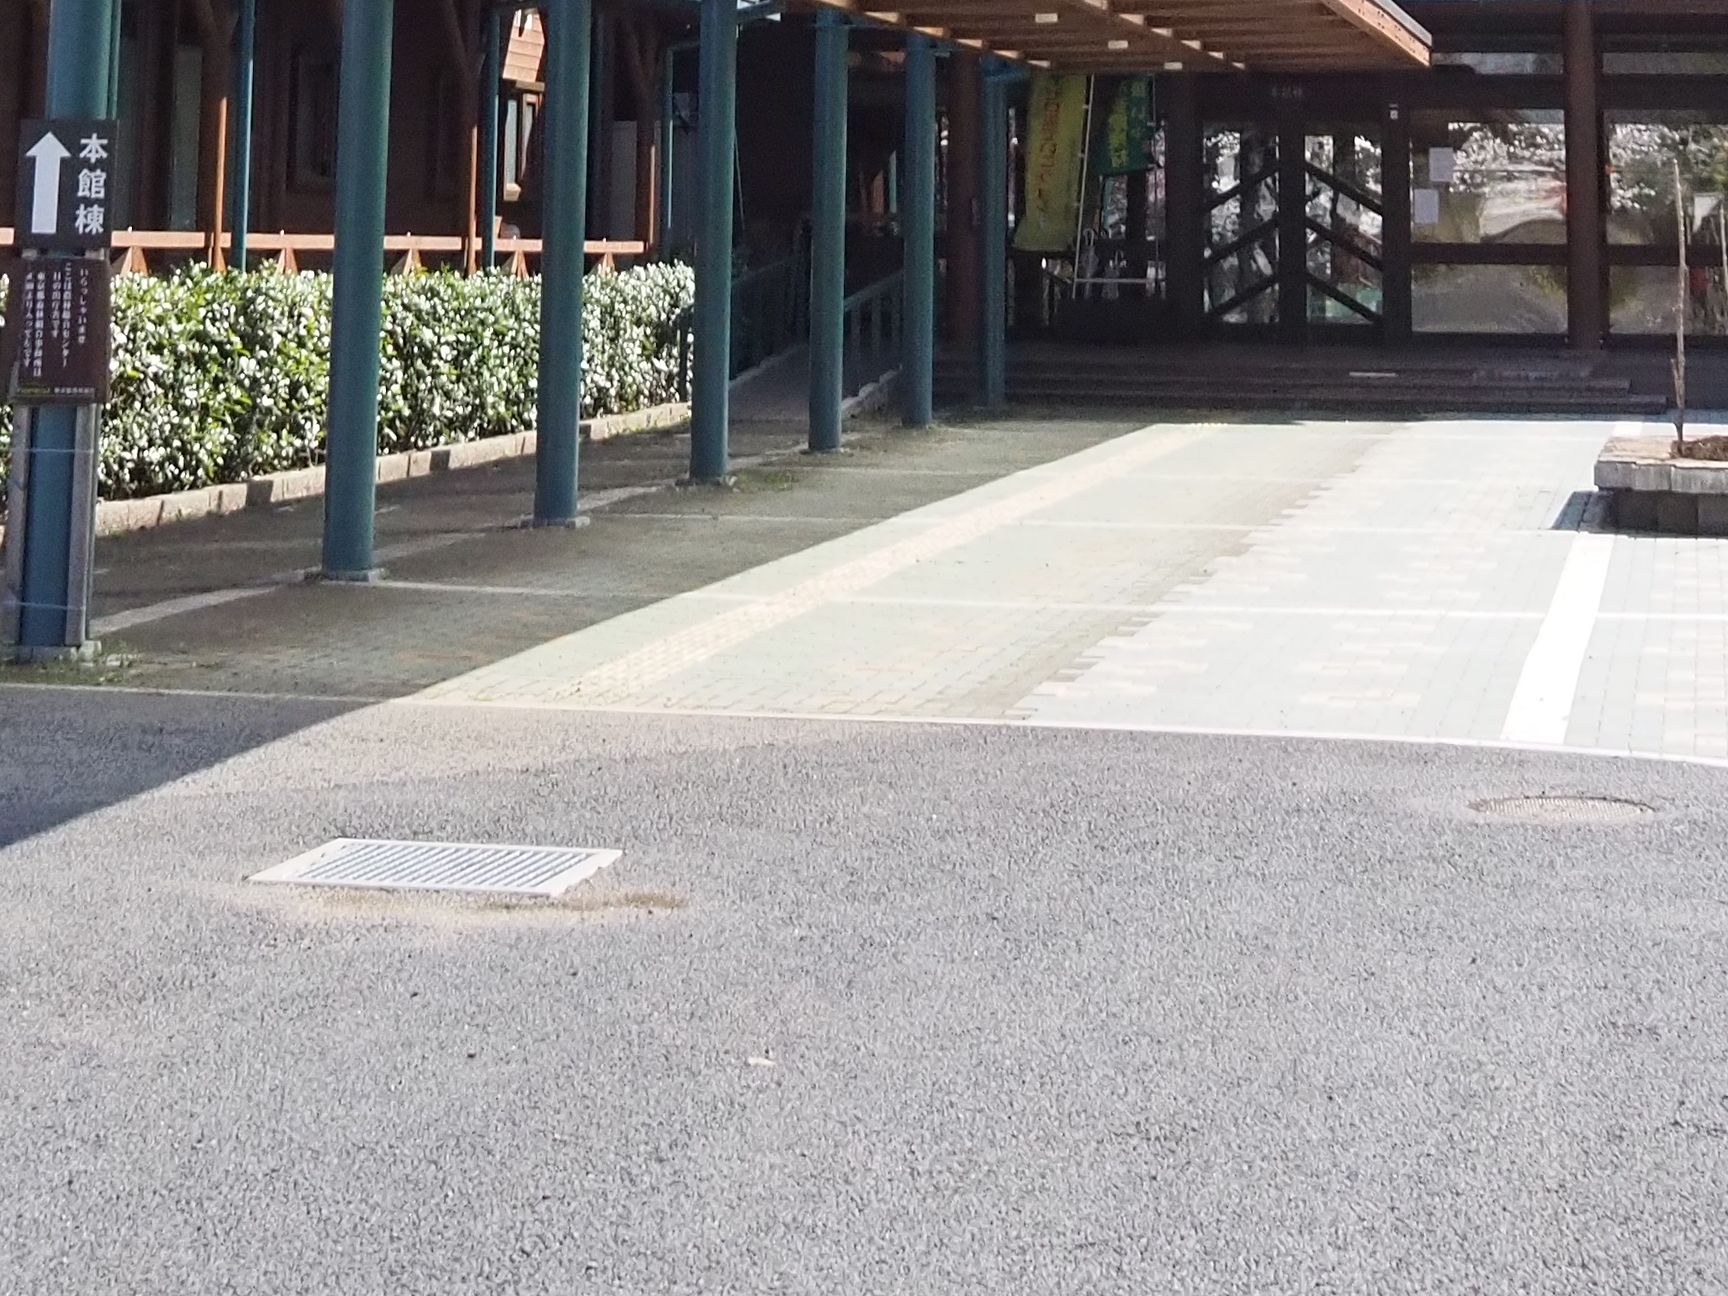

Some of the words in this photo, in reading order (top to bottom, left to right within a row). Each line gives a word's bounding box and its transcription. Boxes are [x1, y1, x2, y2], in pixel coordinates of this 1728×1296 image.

[75, 133, 108, 235] 本館棟
[77, 268, 89, 344] いらっしゃいませ
